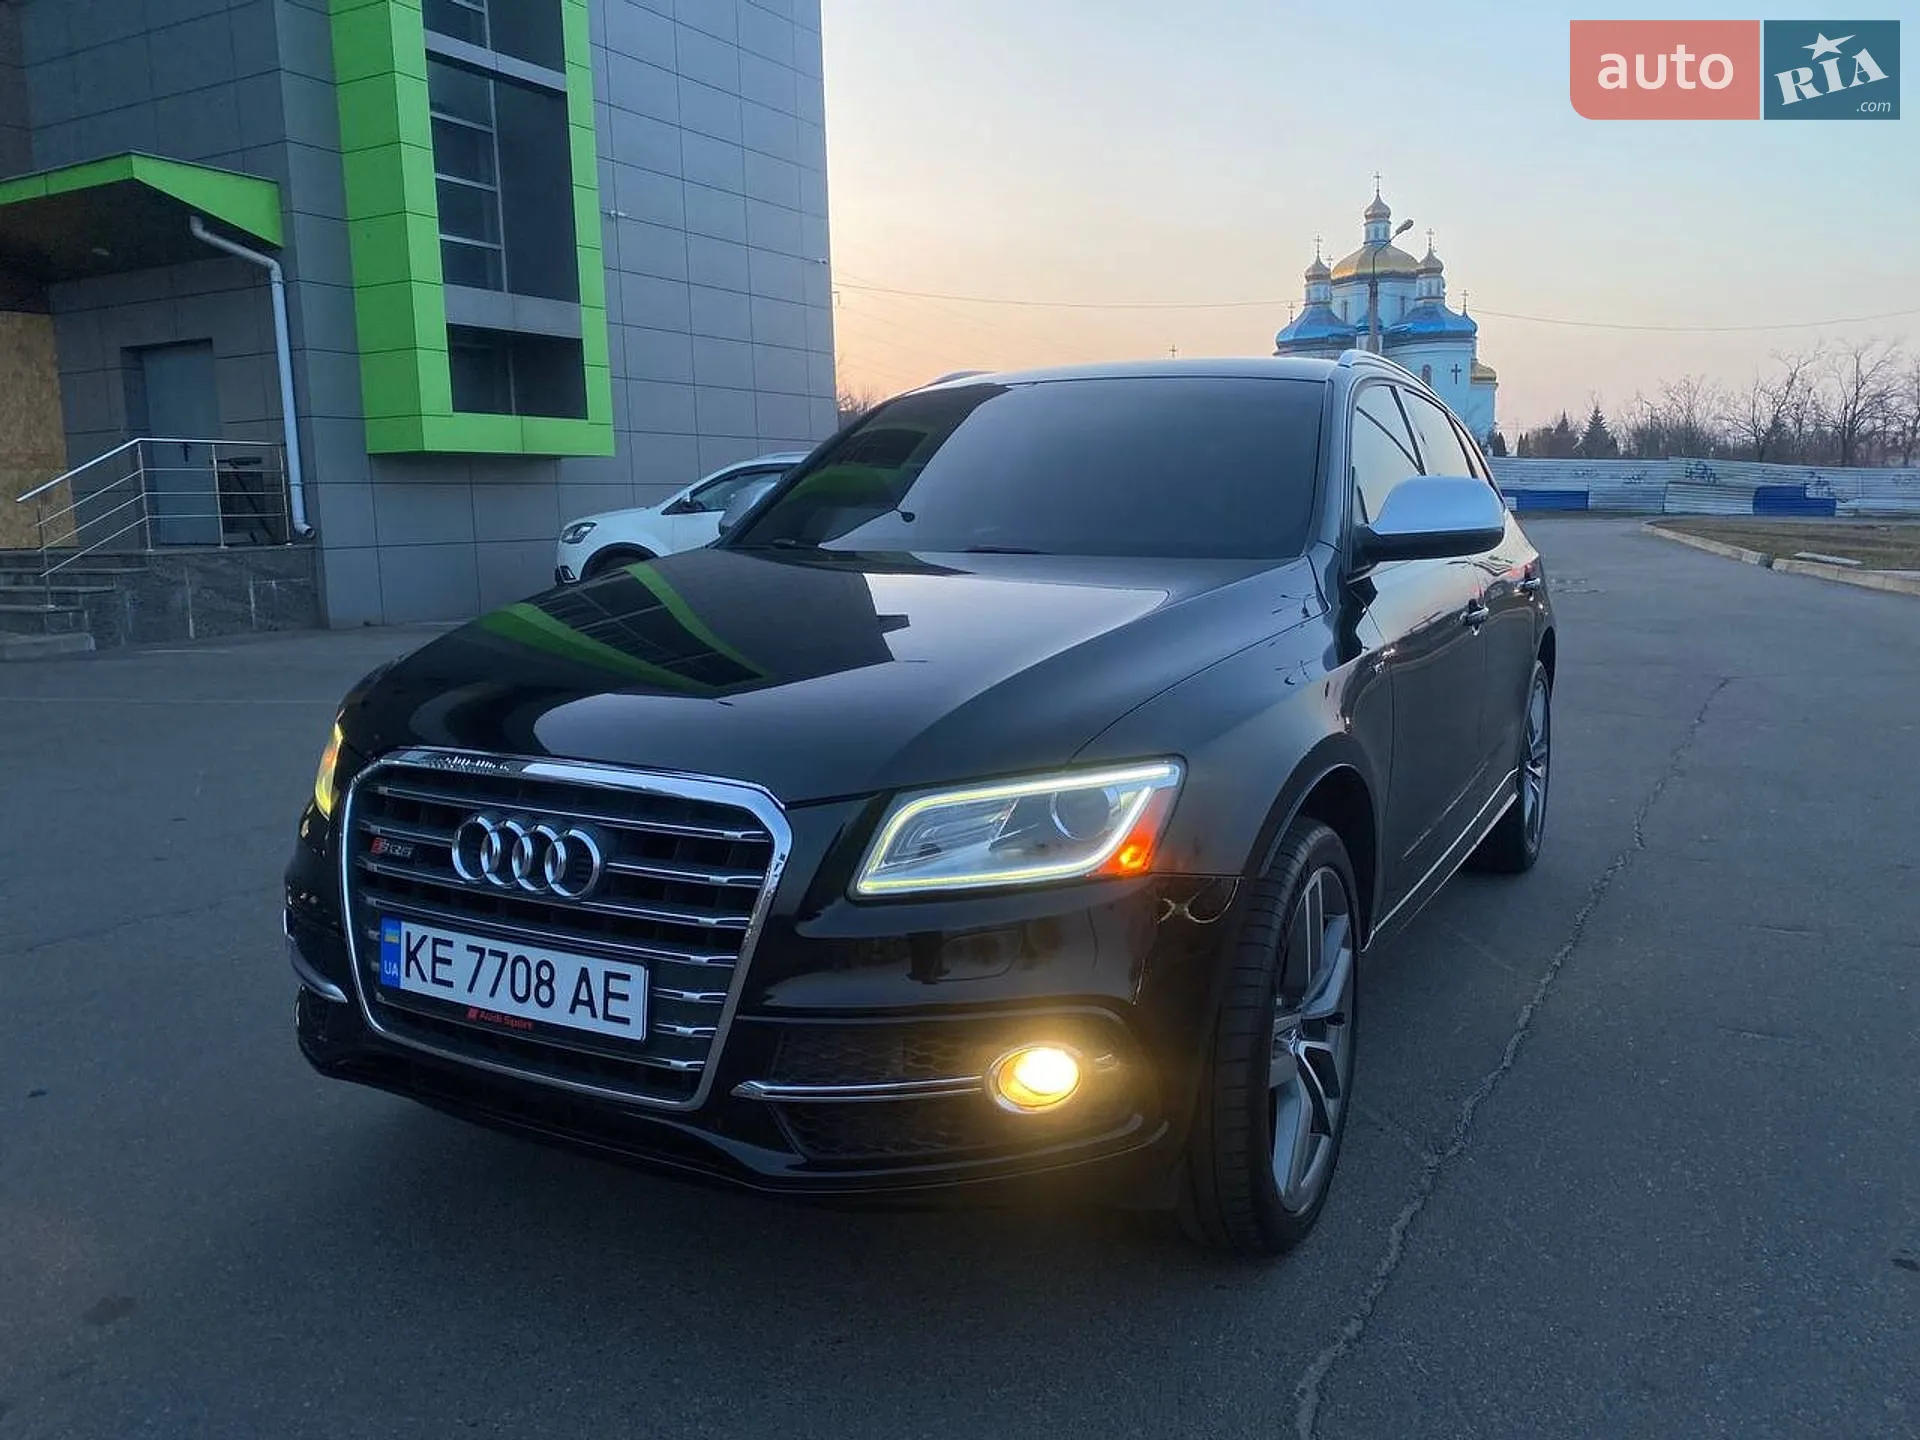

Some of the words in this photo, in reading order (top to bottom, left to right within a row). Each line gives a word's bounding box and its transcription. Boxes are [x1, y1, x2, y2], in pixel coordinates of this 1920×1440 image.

[384, 960, 399, 977] UA
[405, 931, 454, 988] KE
[466, 944, 555, 1009] 7708
[569, 966, 631, 1026] AE
